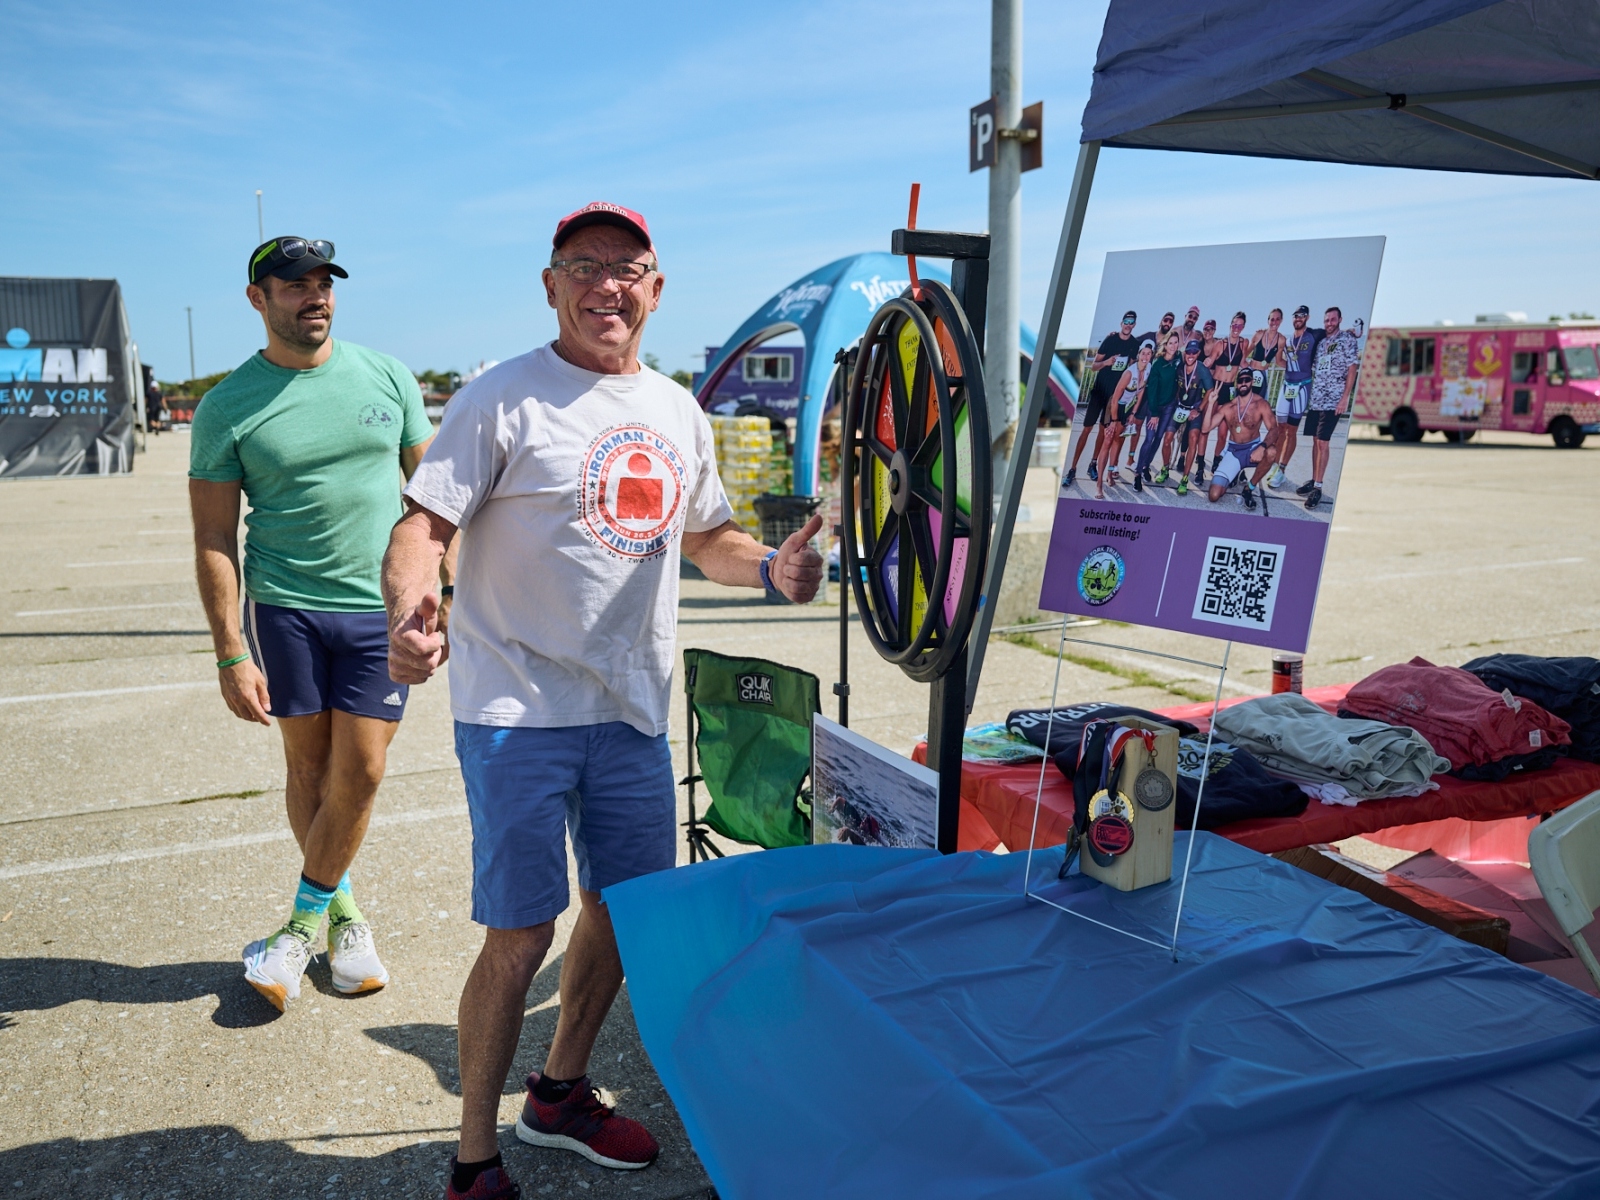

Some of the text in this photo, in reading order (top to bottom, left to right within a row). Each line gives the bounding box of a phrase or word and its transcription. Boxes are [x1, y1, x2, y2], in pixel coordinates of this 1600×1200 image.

[977, 113, 993, 162] P
[0, 388, 107, 404] EW YORK
[1177, 412, 1186, 421] 83
[588, 431, 645, 479] IRONMAN
[1079, 508, 1151, 524] Subscribe to our
[1083, 525, 1141, 541] email listing!
[582, 527, 599, 545] JULY
[607, 550, 617, 558] 30
